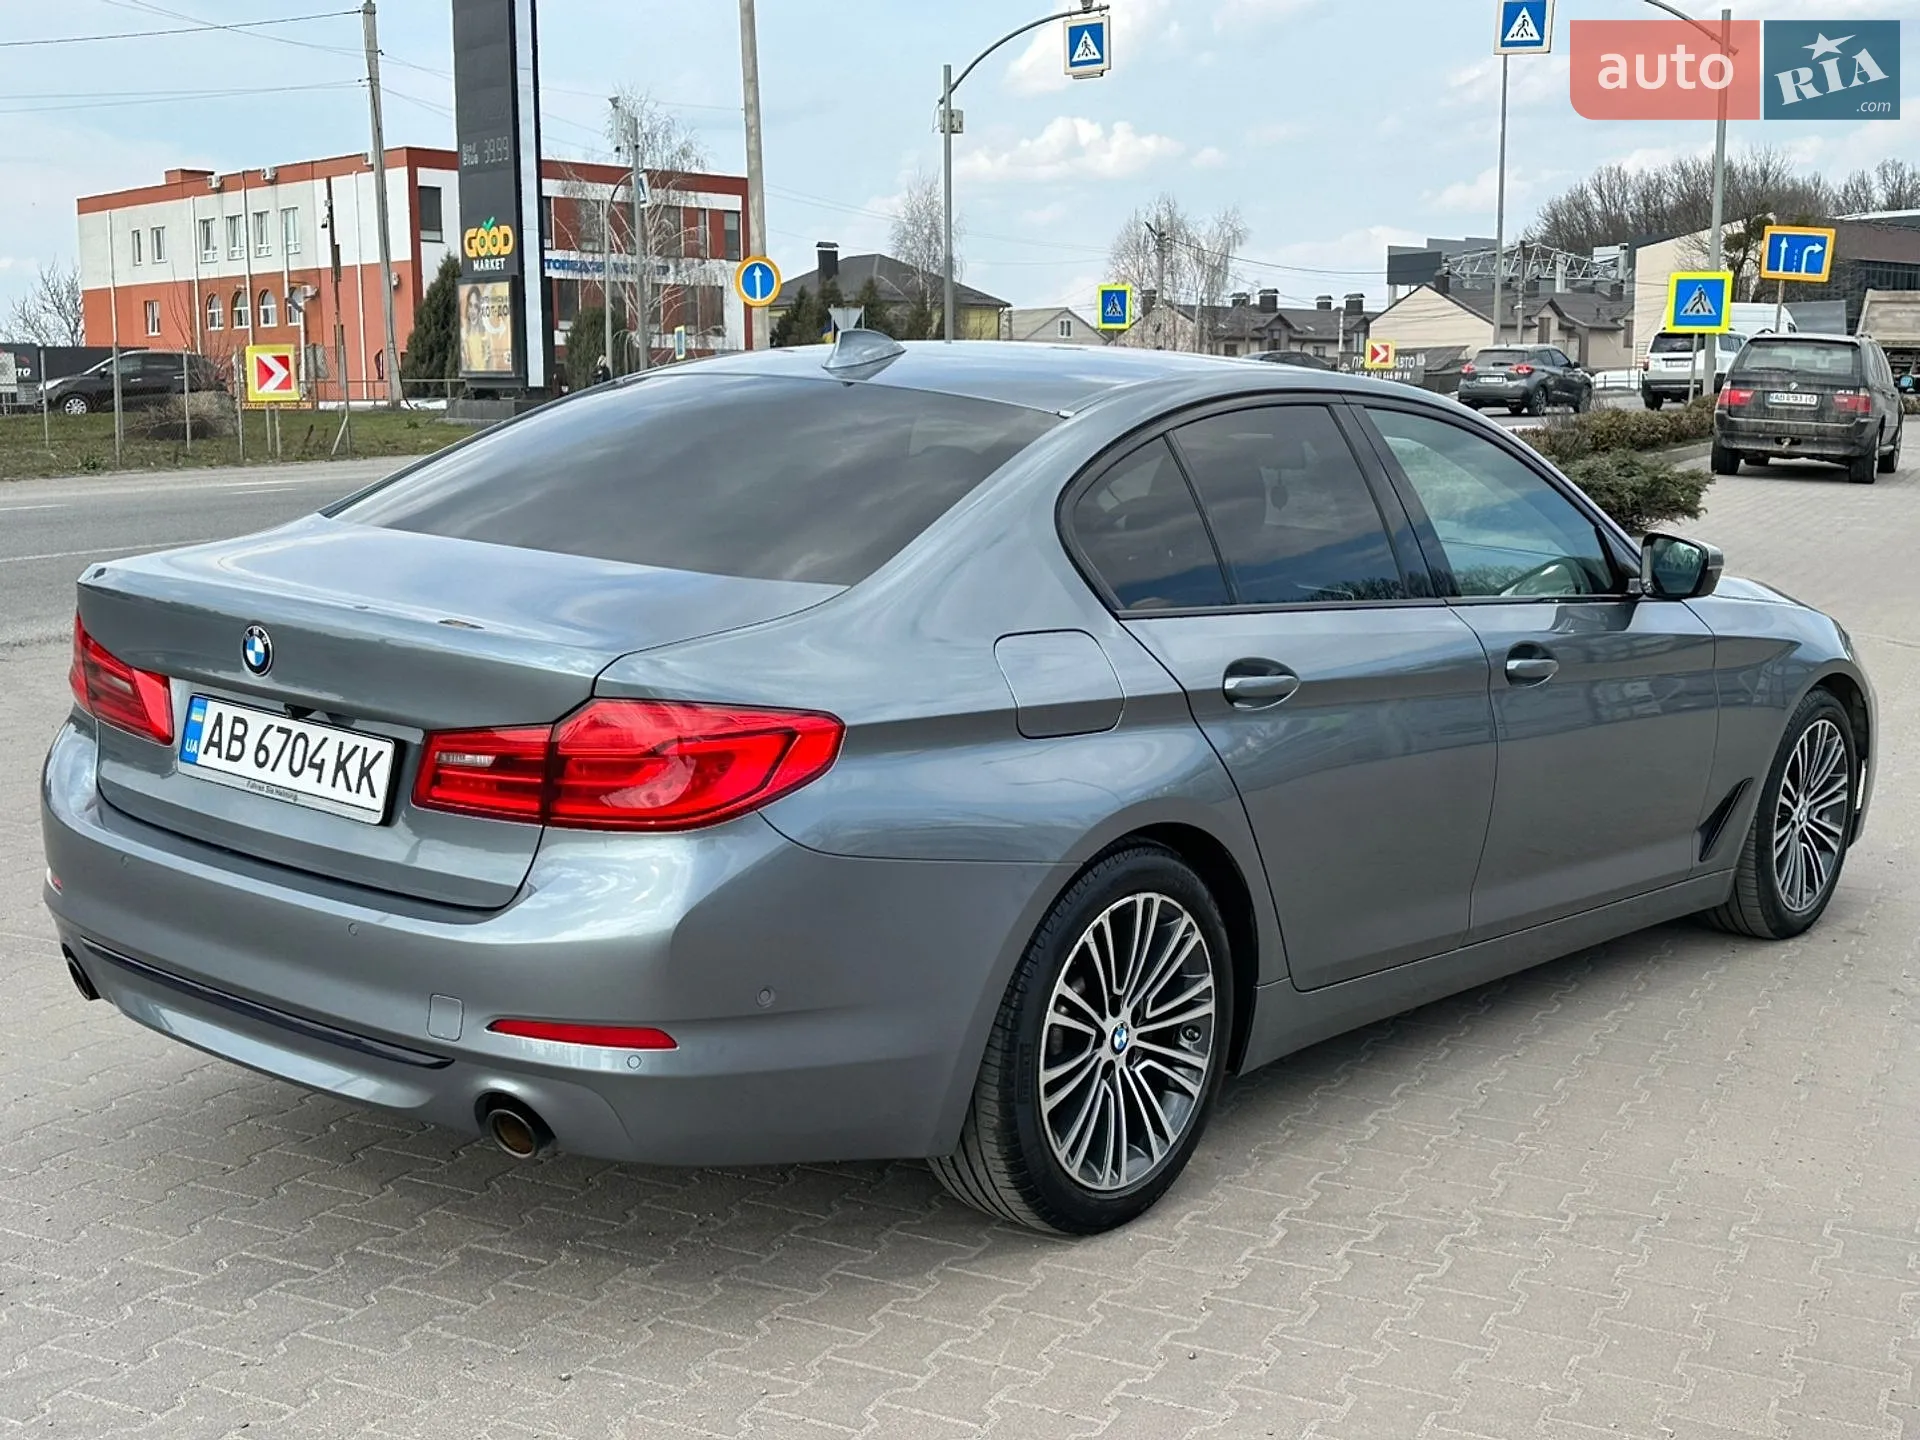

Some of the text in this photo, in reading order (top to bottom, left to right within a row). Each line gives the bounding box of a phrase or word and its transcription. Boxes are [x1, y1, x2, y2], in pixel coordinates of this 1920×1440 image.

[464, 225, 514, 258] GOOD
[472, 257, 506, 271] MARKET
[185, 738, 198, 754] UA
[203, 711, 384, 799] AB 6704 KK
